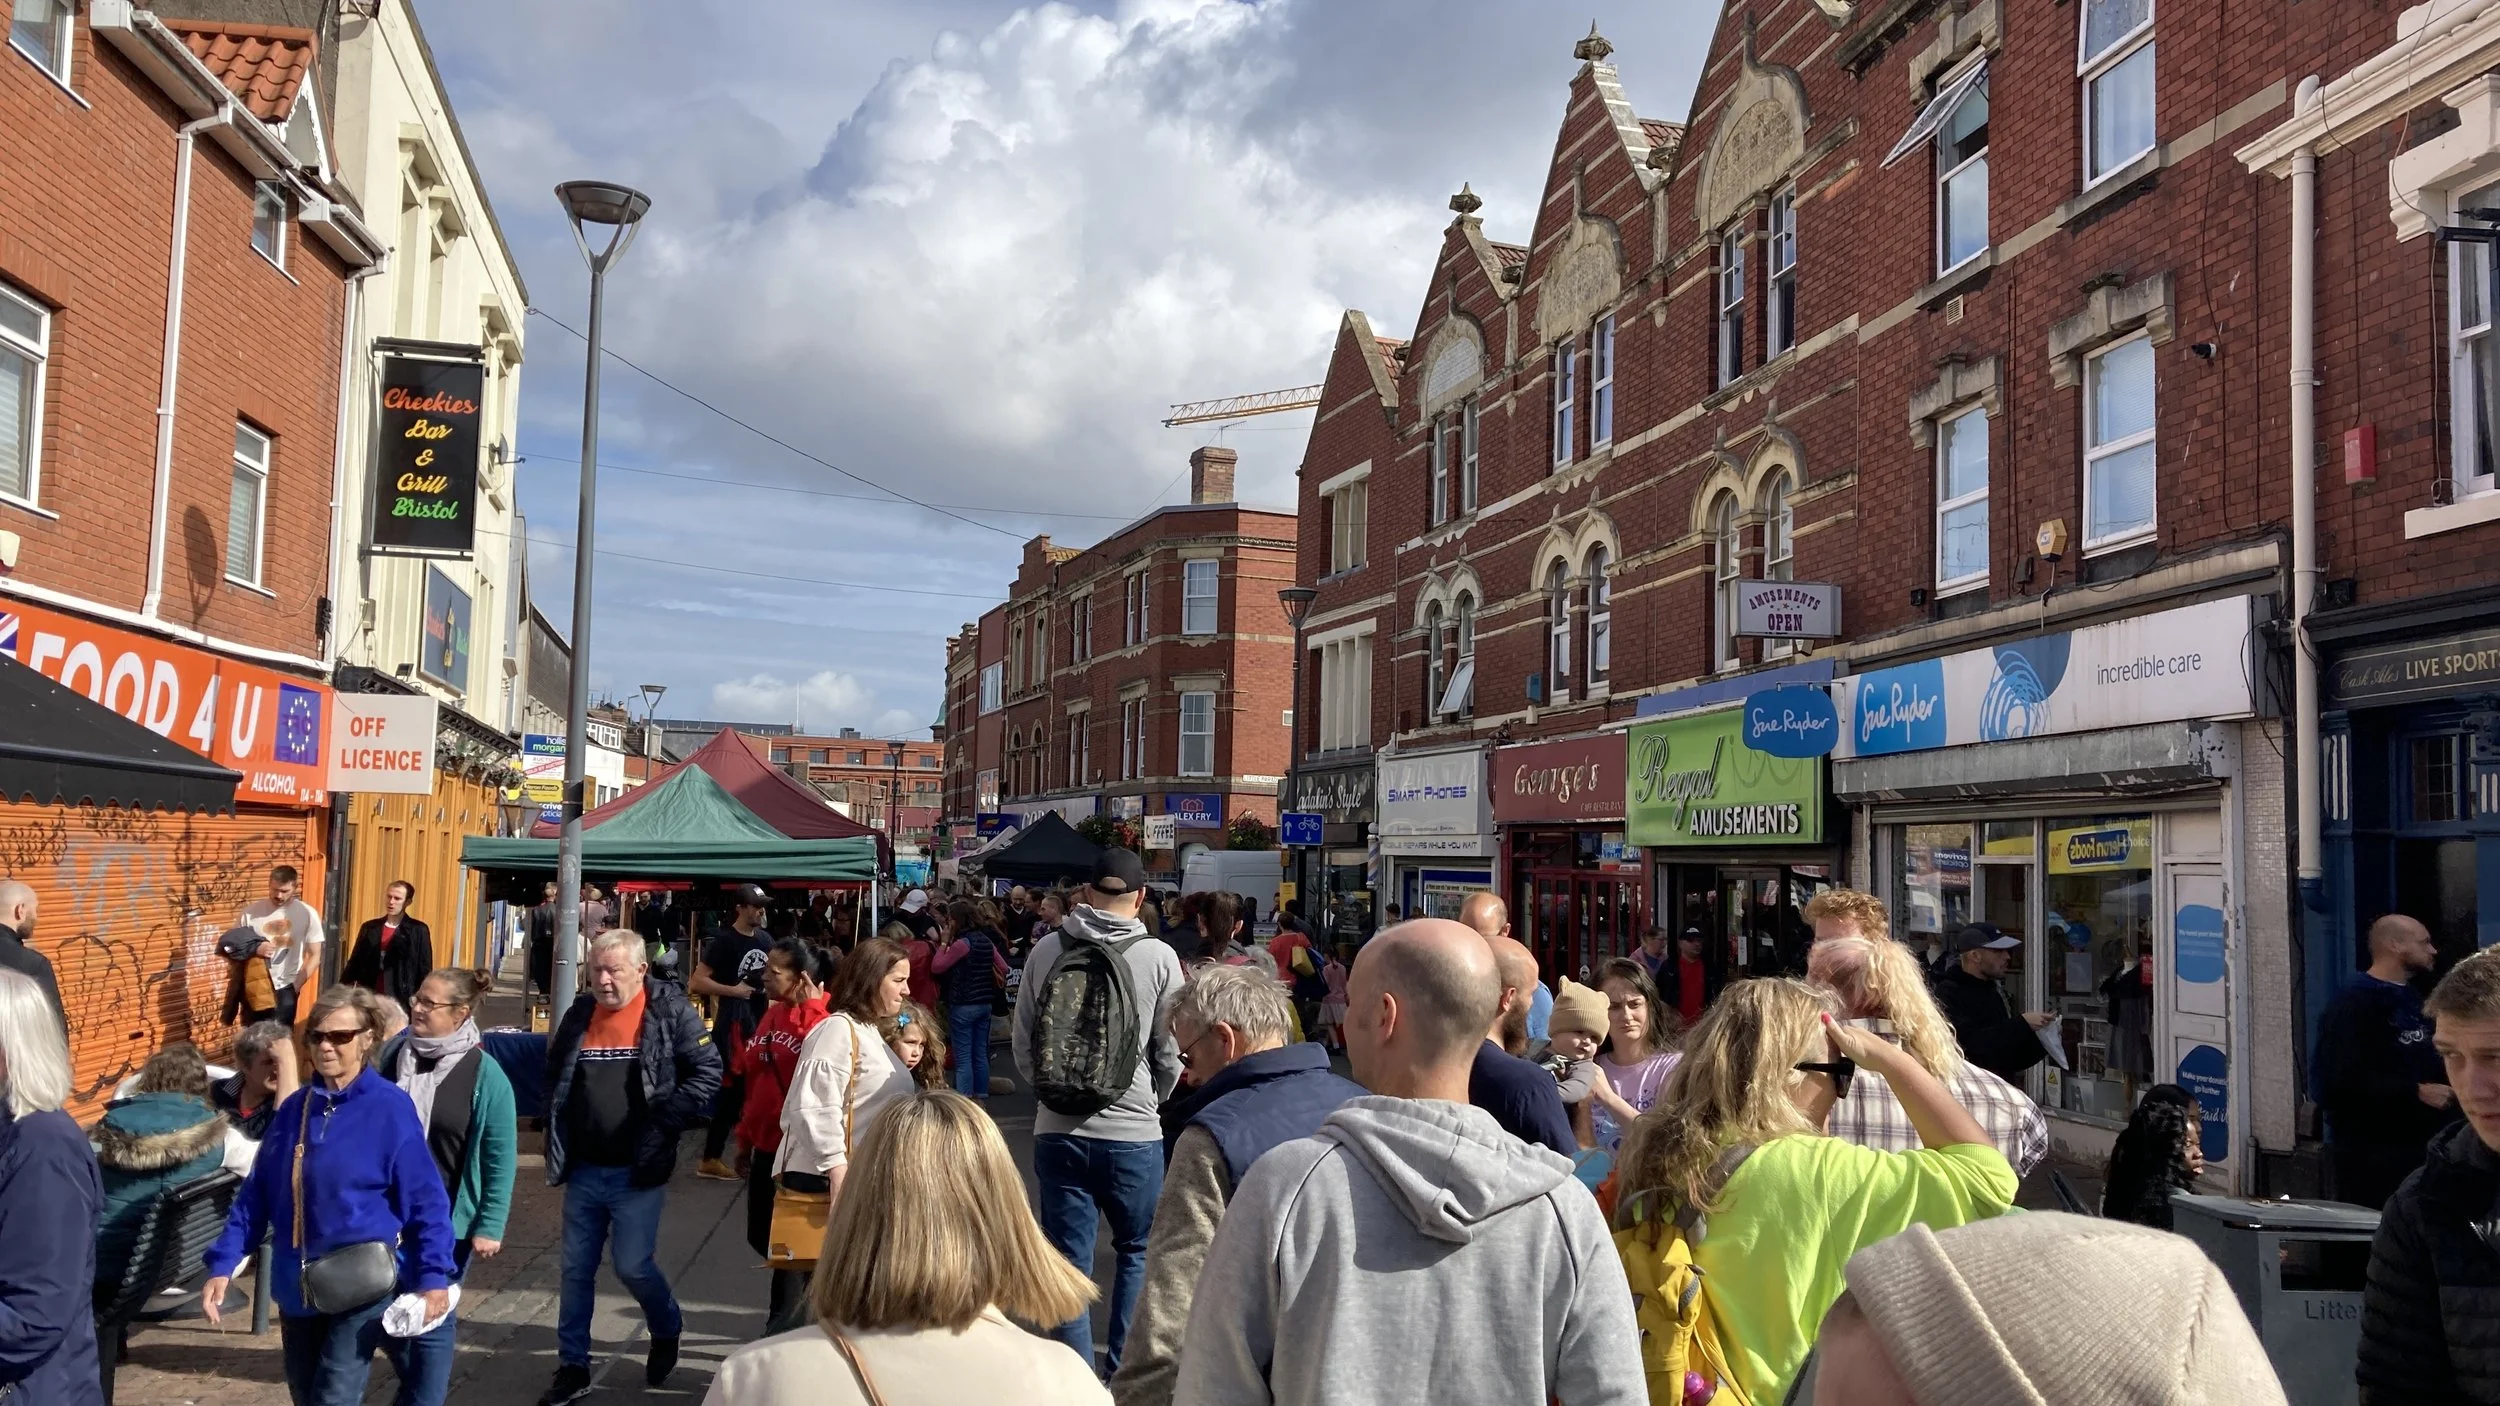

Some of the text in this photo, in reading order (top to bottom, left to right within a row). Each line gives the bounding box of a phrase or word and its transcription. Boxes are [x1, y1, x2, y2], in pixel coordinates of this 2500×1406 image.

[383, 387, 479, 415] Cheekies
[404, 418, 453, 440] Bar
[415, 448, 434, 467] &
[397, 472, 449, 494] Grill
[391, 497, 459, 520] Bristol
[1749, 588, 1822, 611] AMUSEMENTS
[1767, 613, 1803, 632] OPEN
[2096, 651, 2202, 687] incredible care
[2405, 657, 2440, 680] LIVE
[2444, 649, 2500, 675] SPORT
[29, 631, 263, 759] FOOD 4 U
[1752, 707, 1830, 740] Sue Ryder
[1861, 681, 1938, 744] Sue Ryder
[350, 716, 386, 737] OFF
[340, 748, 422, 772] LICENCE
[532, 743, 566, 753] morgan
[250, 771, 296, 796] ALCOHOL
[1514, 754, 1600, 804] George's
[1634, 733, 1725, 832] Regal
[1336, 784, 1362, 817] Style
[1195, 812, 1212, 821] FRY
[1689, 803, 1799, 836] AMUSEMENTS
